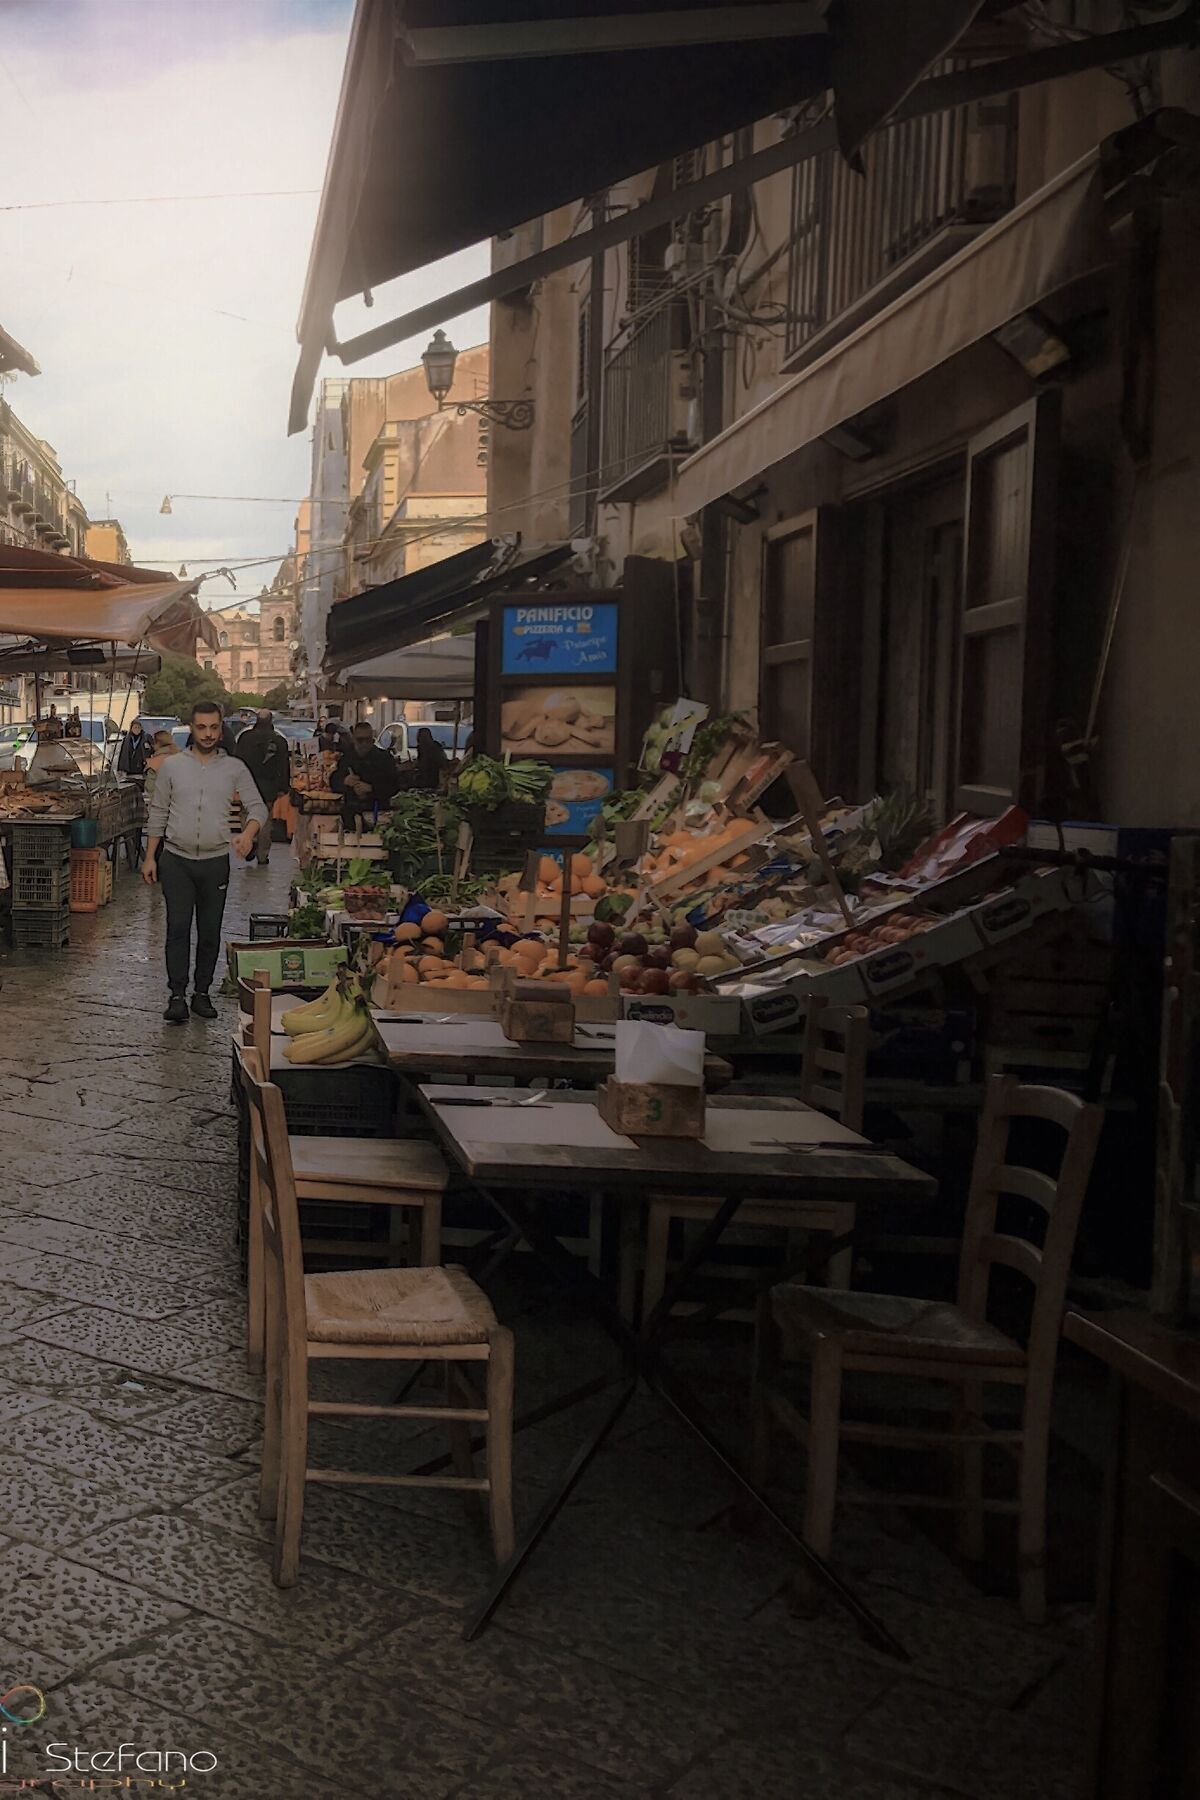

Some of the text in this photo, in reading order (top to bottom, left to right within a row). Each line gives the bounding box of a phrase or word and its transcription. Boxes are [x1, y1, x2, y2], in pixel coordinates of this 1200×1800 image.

[517, 606, 594, 623] PANIFICIO
[523, 624, 563, 635] PIZZERIA
[646, 1096, 663, 1121] 3
